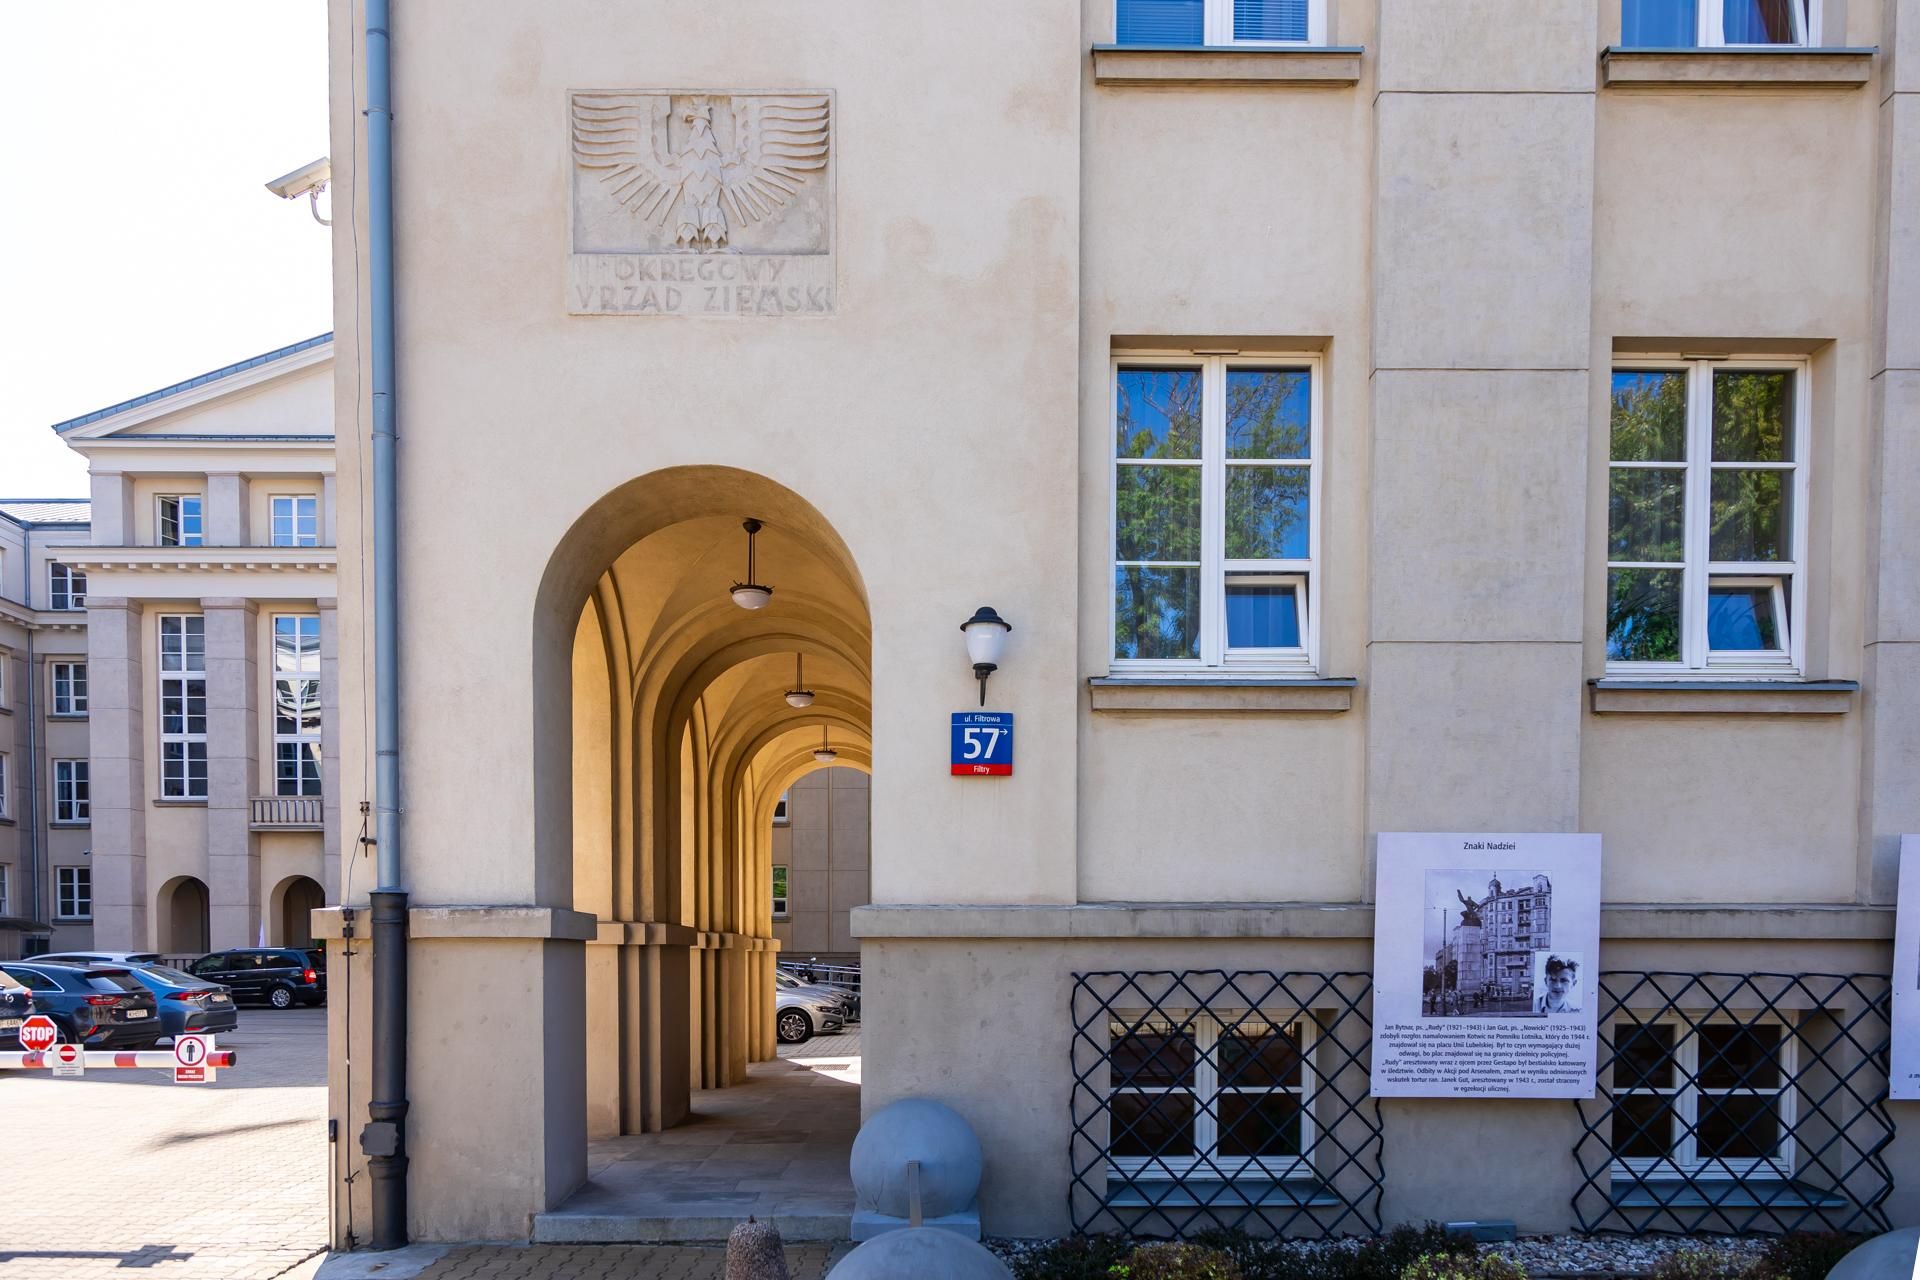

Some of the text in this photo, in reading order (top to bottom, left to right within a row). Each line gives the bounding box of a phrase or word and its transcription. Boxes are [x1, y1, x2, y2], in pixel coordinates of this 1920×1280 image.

[703, 285, 833, 312] ZIEMSKI
[964, 715, 1001, 723] ul. Filtrowa
[964, 728, 999, 759] 57
[973, 765, 990, 774] Filtry
[1463, 841, 1516, 850] Znaki Nadziei
[22, 1027, 54, 1042] STOP
[1436, 1042, 1452, 1050] placu
[1497, 1042, 1506, 1050] Był
[1432, 1050, 1443, 1058] plac
[1459, 1059, 1475, 1067] ojcem
[1458, 1068, 1469, 1076] pod
[1556, 1077, 1580, 1085] stracony
